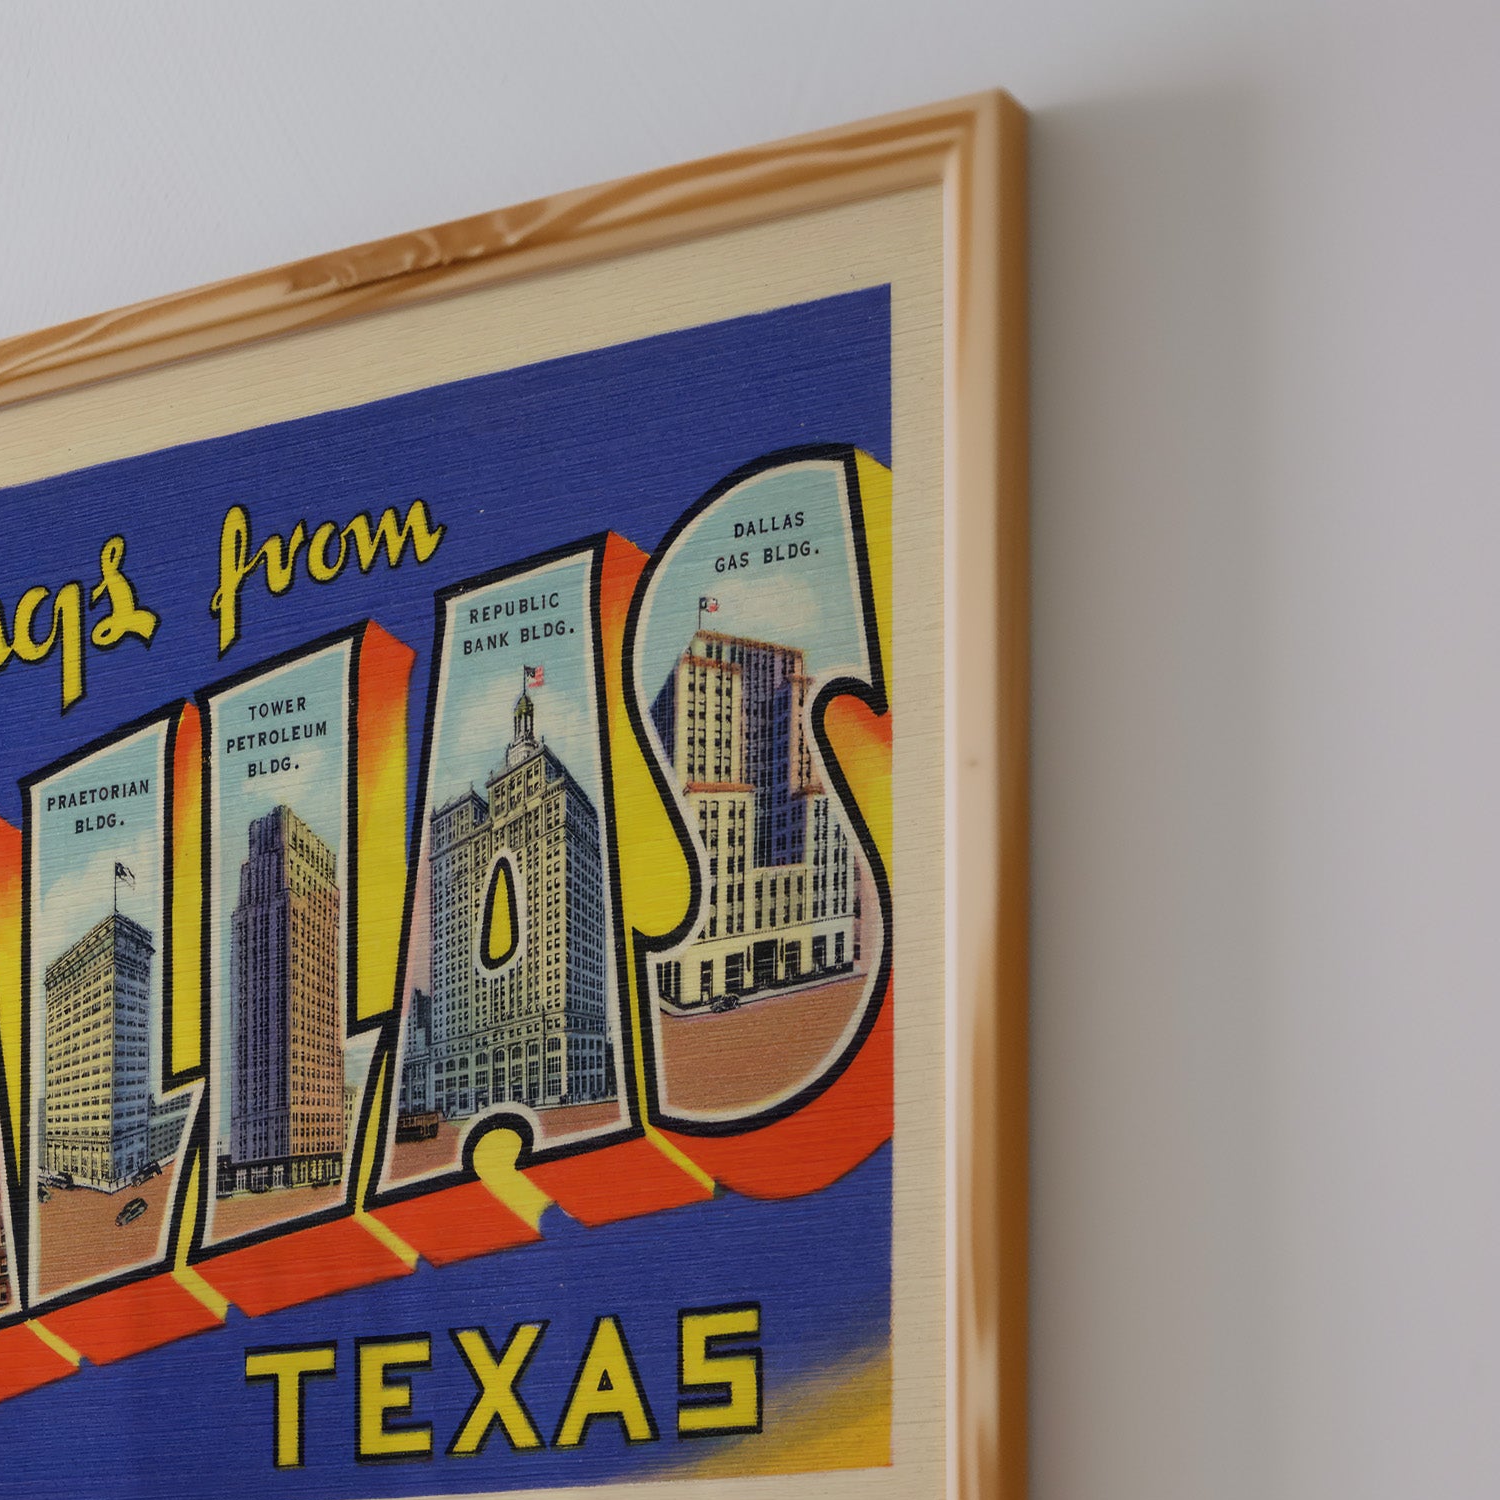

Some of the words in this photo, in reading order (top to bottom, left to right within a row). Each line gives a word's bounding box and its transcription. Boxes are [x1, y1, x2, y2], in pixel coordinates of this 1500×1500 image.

[733, 511, 806, 539] DALLAS
[714, 552, 750, 574] GAS
[763, 540, 820, 564] BLDG.
[209, 497, 445, 661] from
[469, 592, 560, 625] REPUBLIC
[463, 631, 509, 656] BANK
[520, 618, 576, 643] BLDG.
[248, 697, 307, 721] TOWER
[226, 721, 328, 754] PETROLEUM
[248, 757, 300, 778] BLDG.
[47, 779, 150, 811] PRAETORIAN
[75, 814, 125, 834] BLDG.
[243, 1300, 764, 1470] TEXAS
